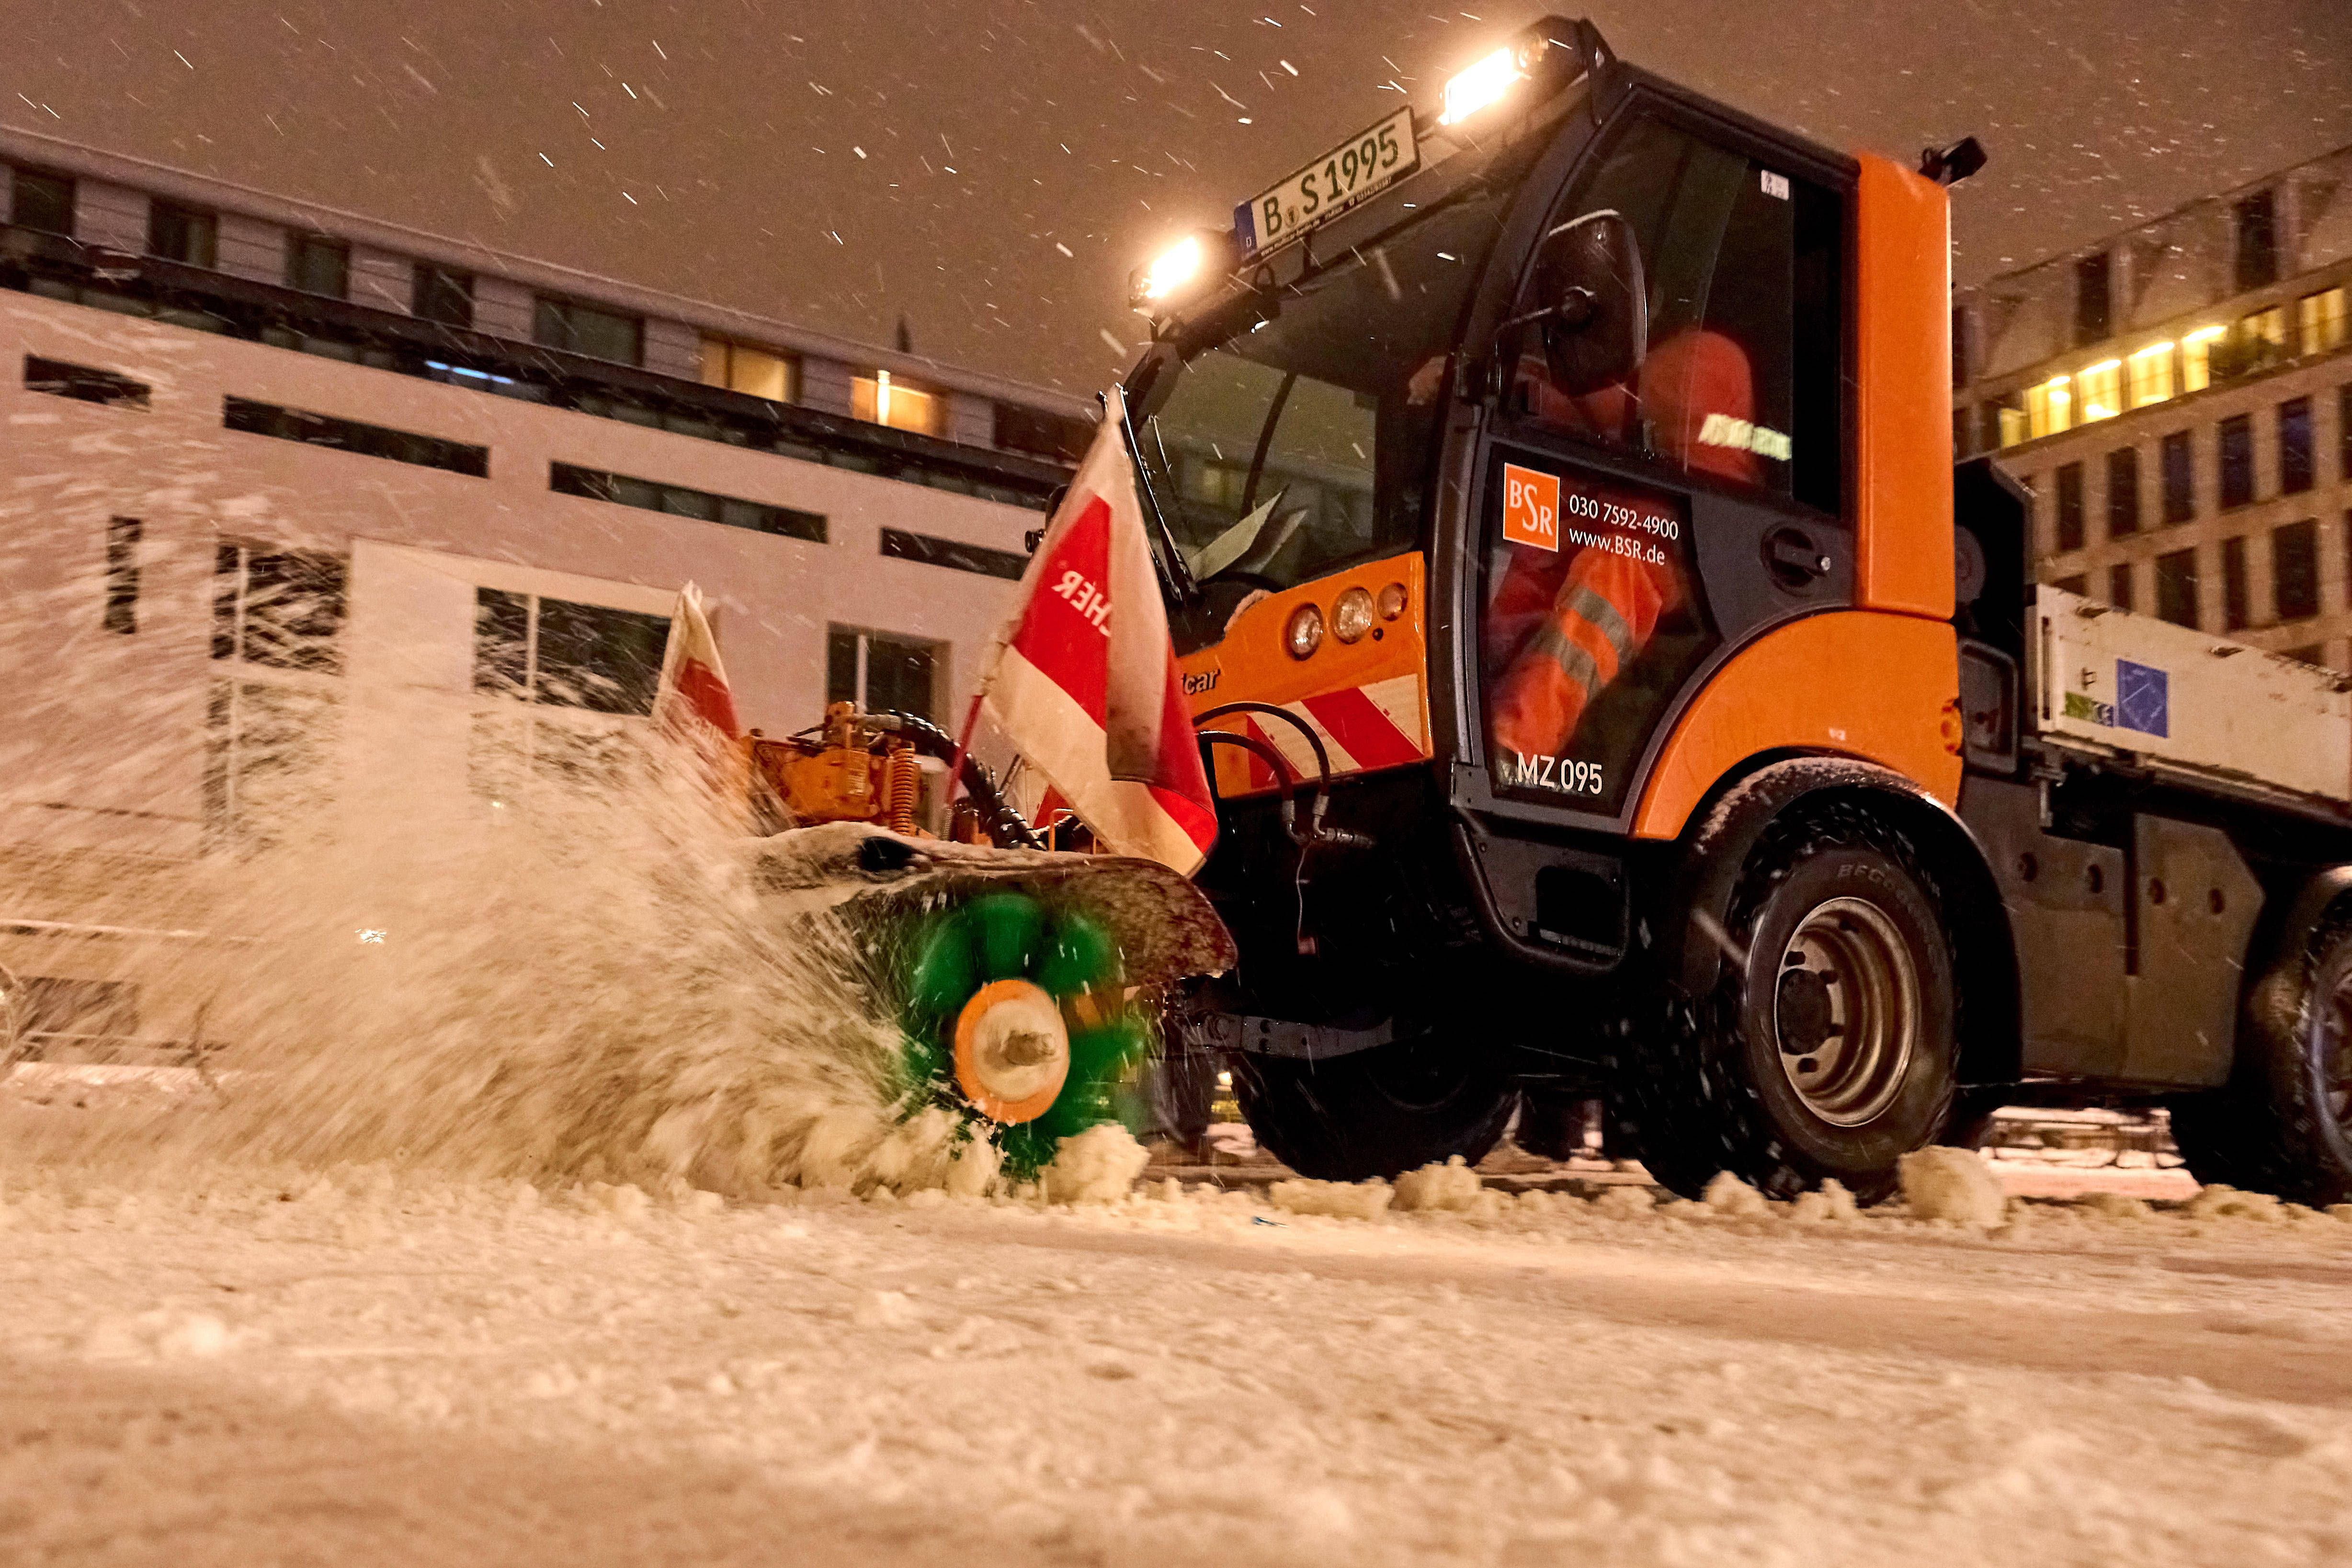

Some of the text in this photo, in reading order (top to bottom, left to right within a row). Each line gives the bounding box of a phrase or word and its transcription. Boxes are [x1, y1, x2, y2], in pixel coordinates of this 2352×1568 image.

[1263, 196, 1283, 238] B
[1510, 479, 1553, 536] BSR
[1569, 494, 1679, 540] 030 7592-4900
[1569, 528, 1665, 566] www.BSR.de
[1518, 751, 1602, 795] MZ 095
